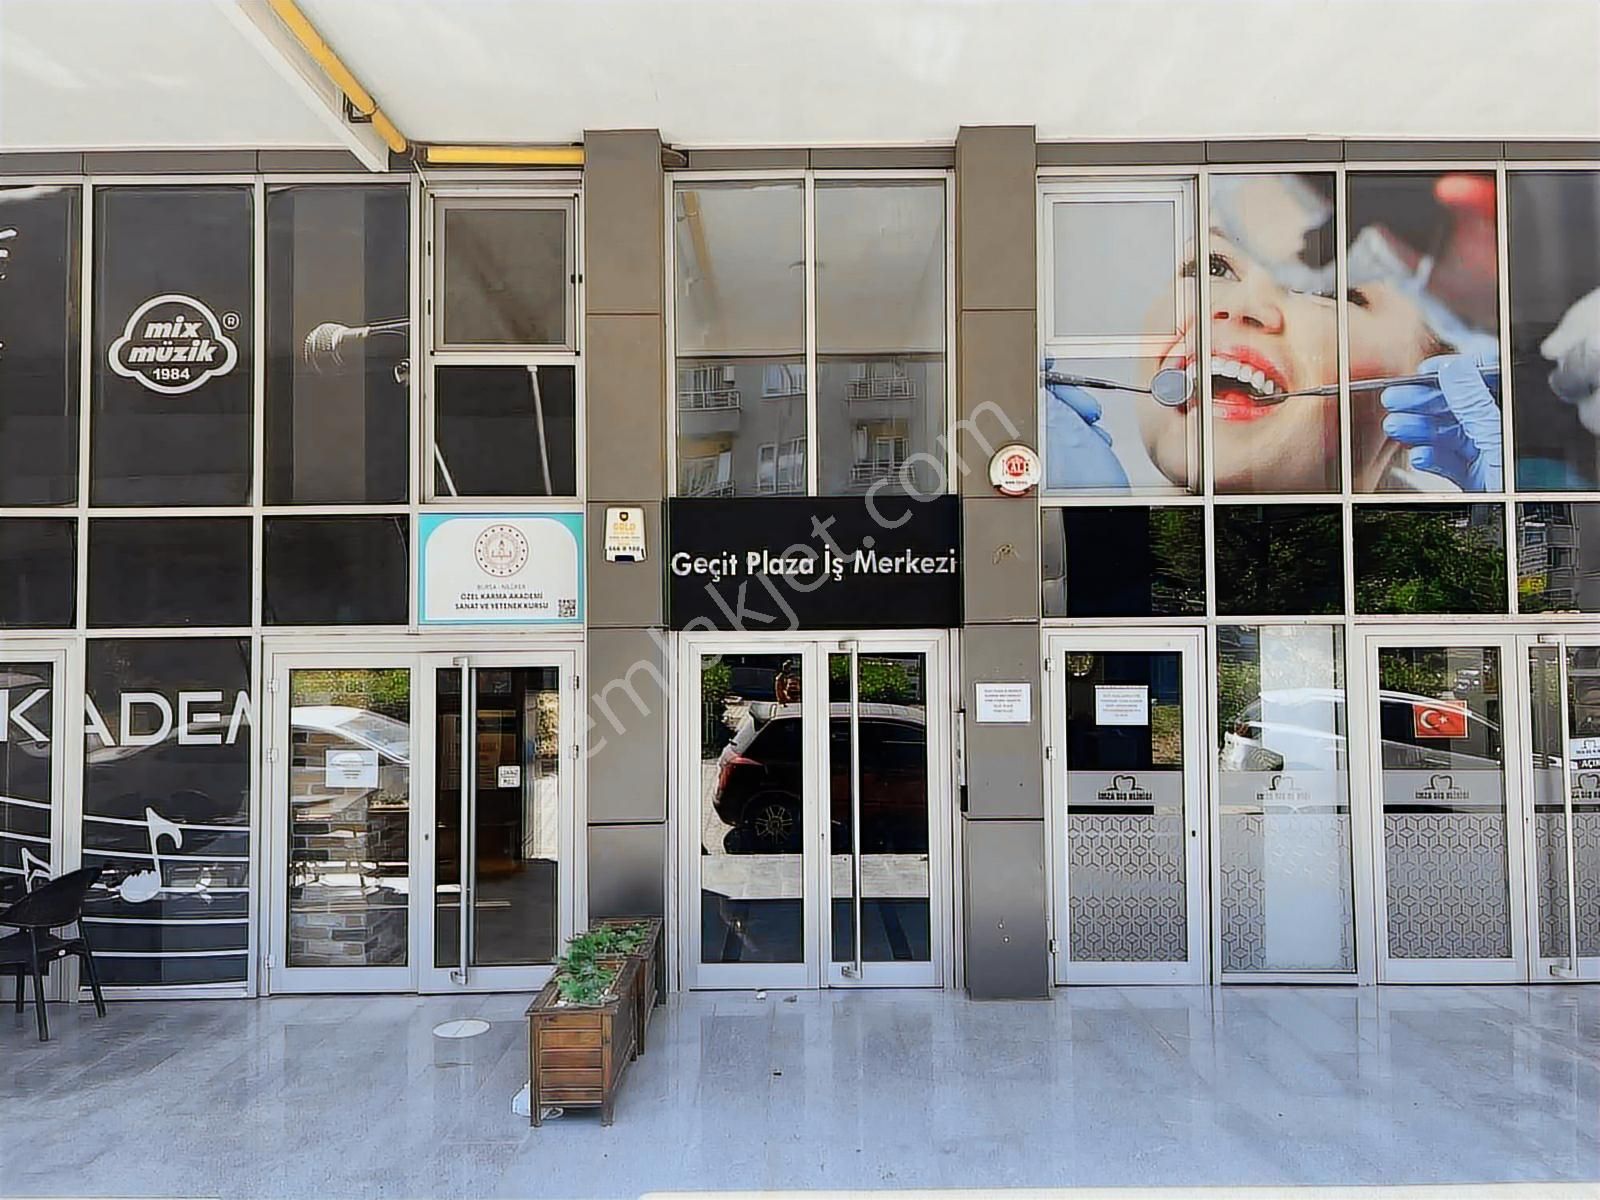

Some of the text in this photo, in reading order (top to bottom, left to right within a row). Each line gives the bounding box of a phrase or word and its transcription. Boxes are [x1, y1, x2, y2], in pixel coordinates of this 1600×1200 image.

[144, 315, 203, 338] mix
[128, 339, 218, 362] müzik
[153, 368, 190, 380] 1984
[671, 543, 957, 582] Geçit Plaza İş Merkezi
